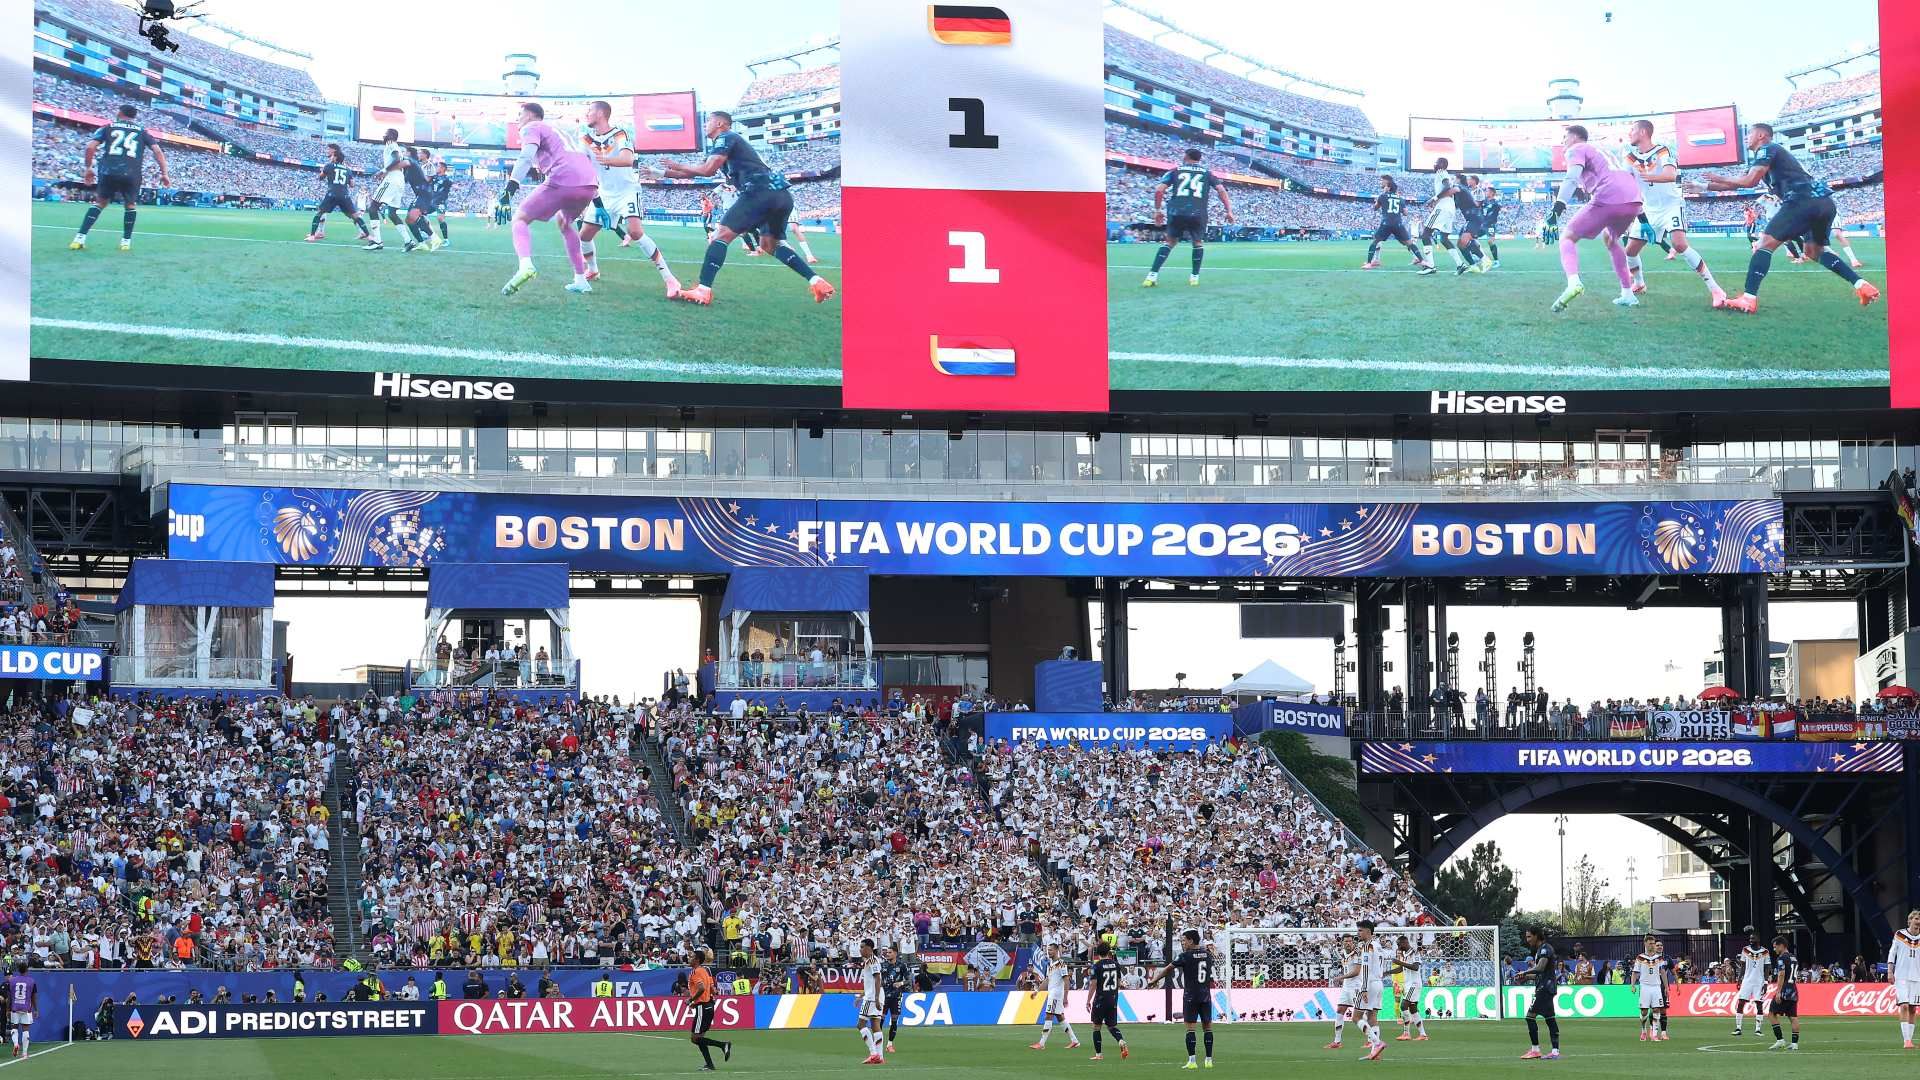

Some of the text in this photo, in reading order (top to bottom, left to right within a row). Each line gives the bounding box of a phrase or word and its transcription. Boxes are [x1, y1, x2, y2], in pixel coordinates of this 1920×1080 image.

[948, 98, 999, 149] 1
[108, 130, 140, 158] 24
[333, 168, 348, 184] 15
[1177, 172, 1204, 198] 24
[627, 202, 636, 214] 3
[1387, 199, 1400, 214] 15
[1671, 216, 1681, 228] 3
[948, 231, 1000, 284] 1
[373, 371, 515, 400] Hisense
[1430, 390, 1567, 414] Hisense
[495, 515, 684, 551] BOSTON
[798, 521, 1300, 556] FIFA WORLD CUP 2026
[1412, 523, 1597, 556] BOSTON
[43, 651, 102, 675] CUP
[1200, 697, 1221, 705] LIGH
[1273, 708, 1341, 729] BOSTON
[1680, 711, 1728, 724] SOEST
[1012, 727, 1206, 741] FIFA WORLD CUP 2026
[1680, 725, 1728, 739] RULES
[1518, 749, 1752, 766] FIFA WORLD CUP 2026
[1102, 970, 1118, 991] 23
[1198, 961, 1207, 983] 6
[1425, 987, 1604, 1017] aramco
[150, 1009, 426, 1034] ADI PREDICTSTREET
[453, 1001, 575, 1034] QATAR
